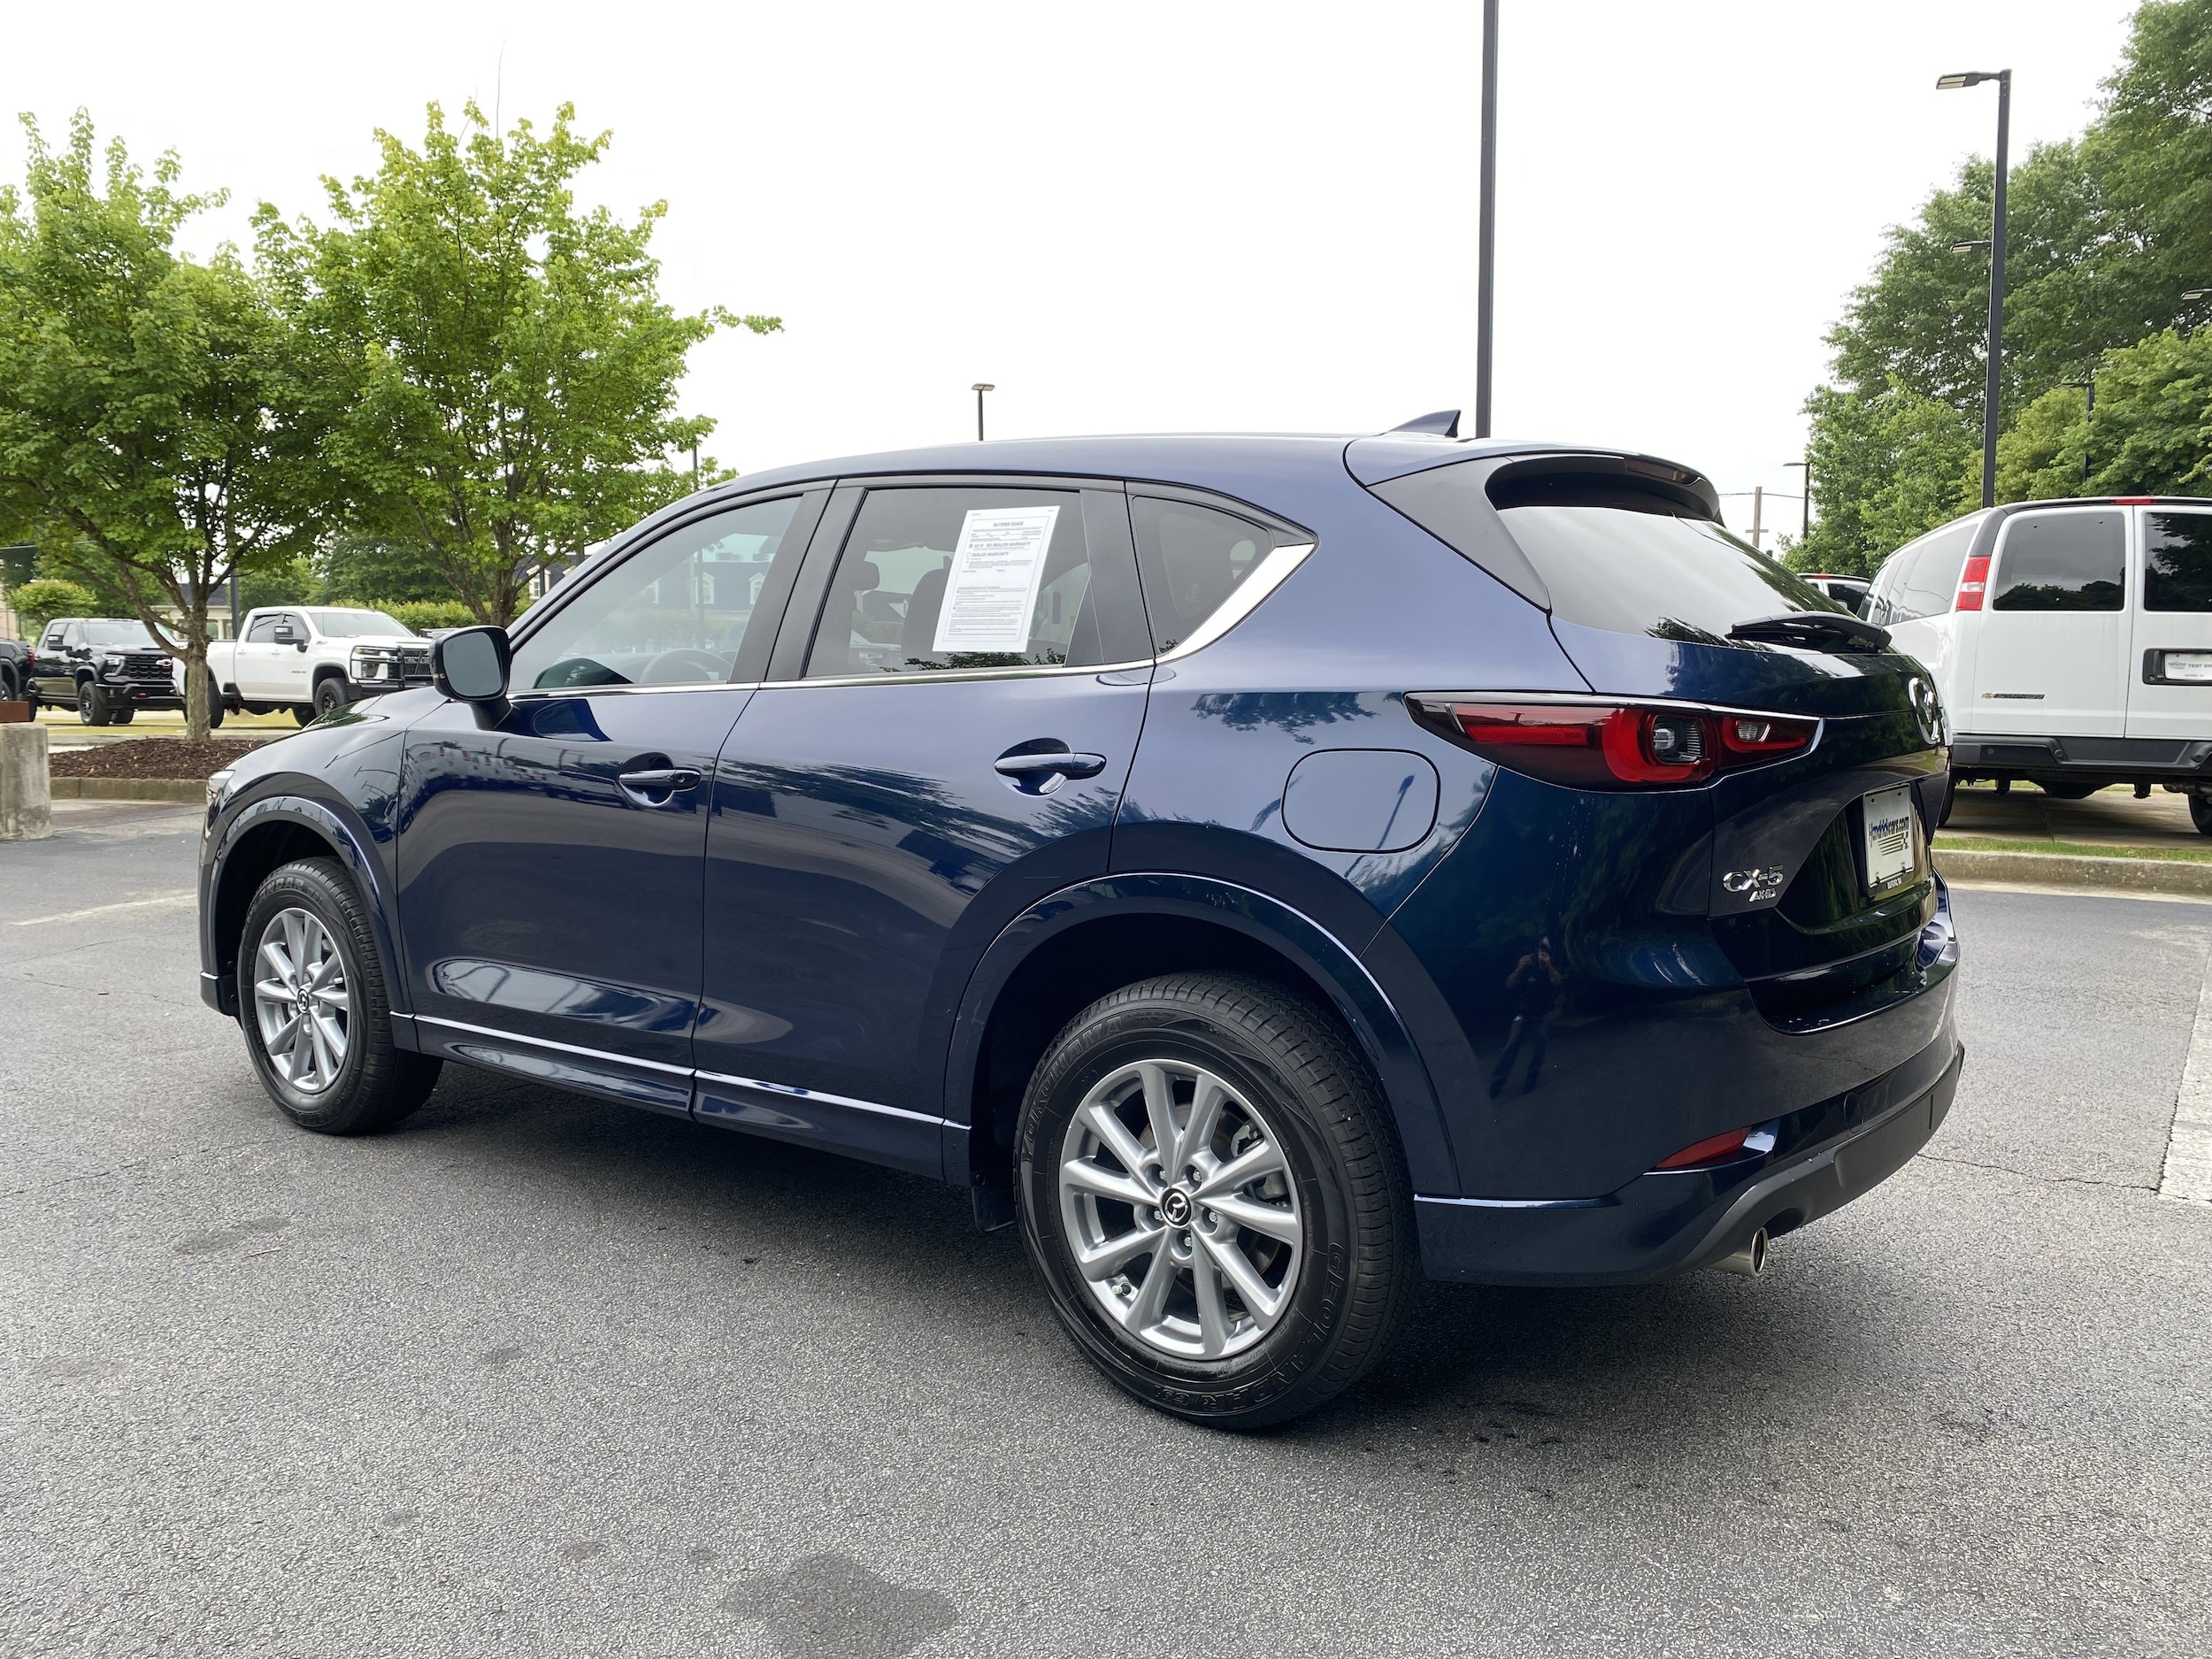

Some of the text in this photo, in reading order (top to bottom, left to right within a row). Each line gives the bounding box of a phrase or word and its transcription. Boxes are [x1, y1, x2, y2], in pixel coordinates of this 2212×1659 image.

[1723, 864, 1784, 893] CX-5
[1748, 887, 1777, 902] AWD
[1022, 1017, 1123, 1163] YOKOHAMA
